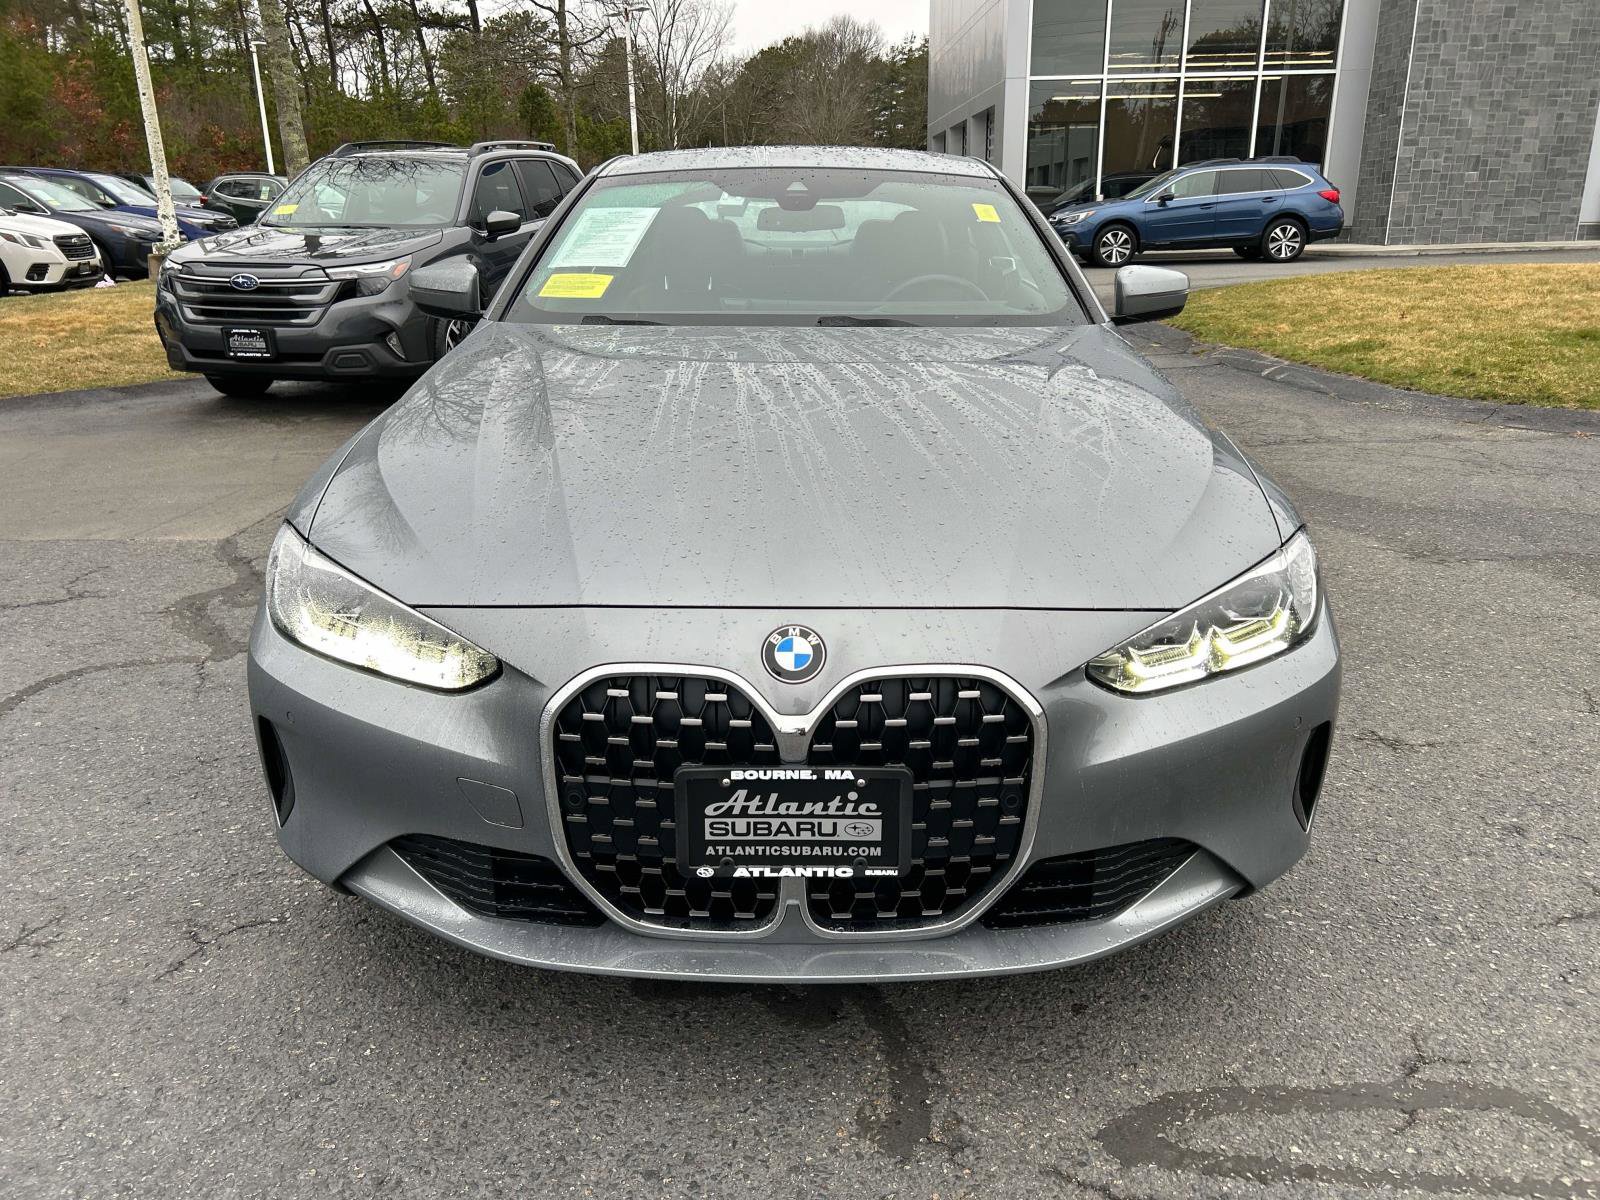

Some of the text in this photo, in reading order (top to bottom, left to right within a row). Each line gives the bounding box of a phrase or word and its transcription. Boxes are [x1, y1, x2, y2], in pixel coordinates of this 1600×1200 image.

[769, 627, 820, 646] BMW
[730, 769, 855, 781] BOURNE, MA
[704, 789, 883, 817] Atlantic
[708, 821, 838, 838] SUBARU
[705, 845, 882, 857] ATLANTICSUBARU.COM
[732, 867, 854, 878] ATLANTIC
